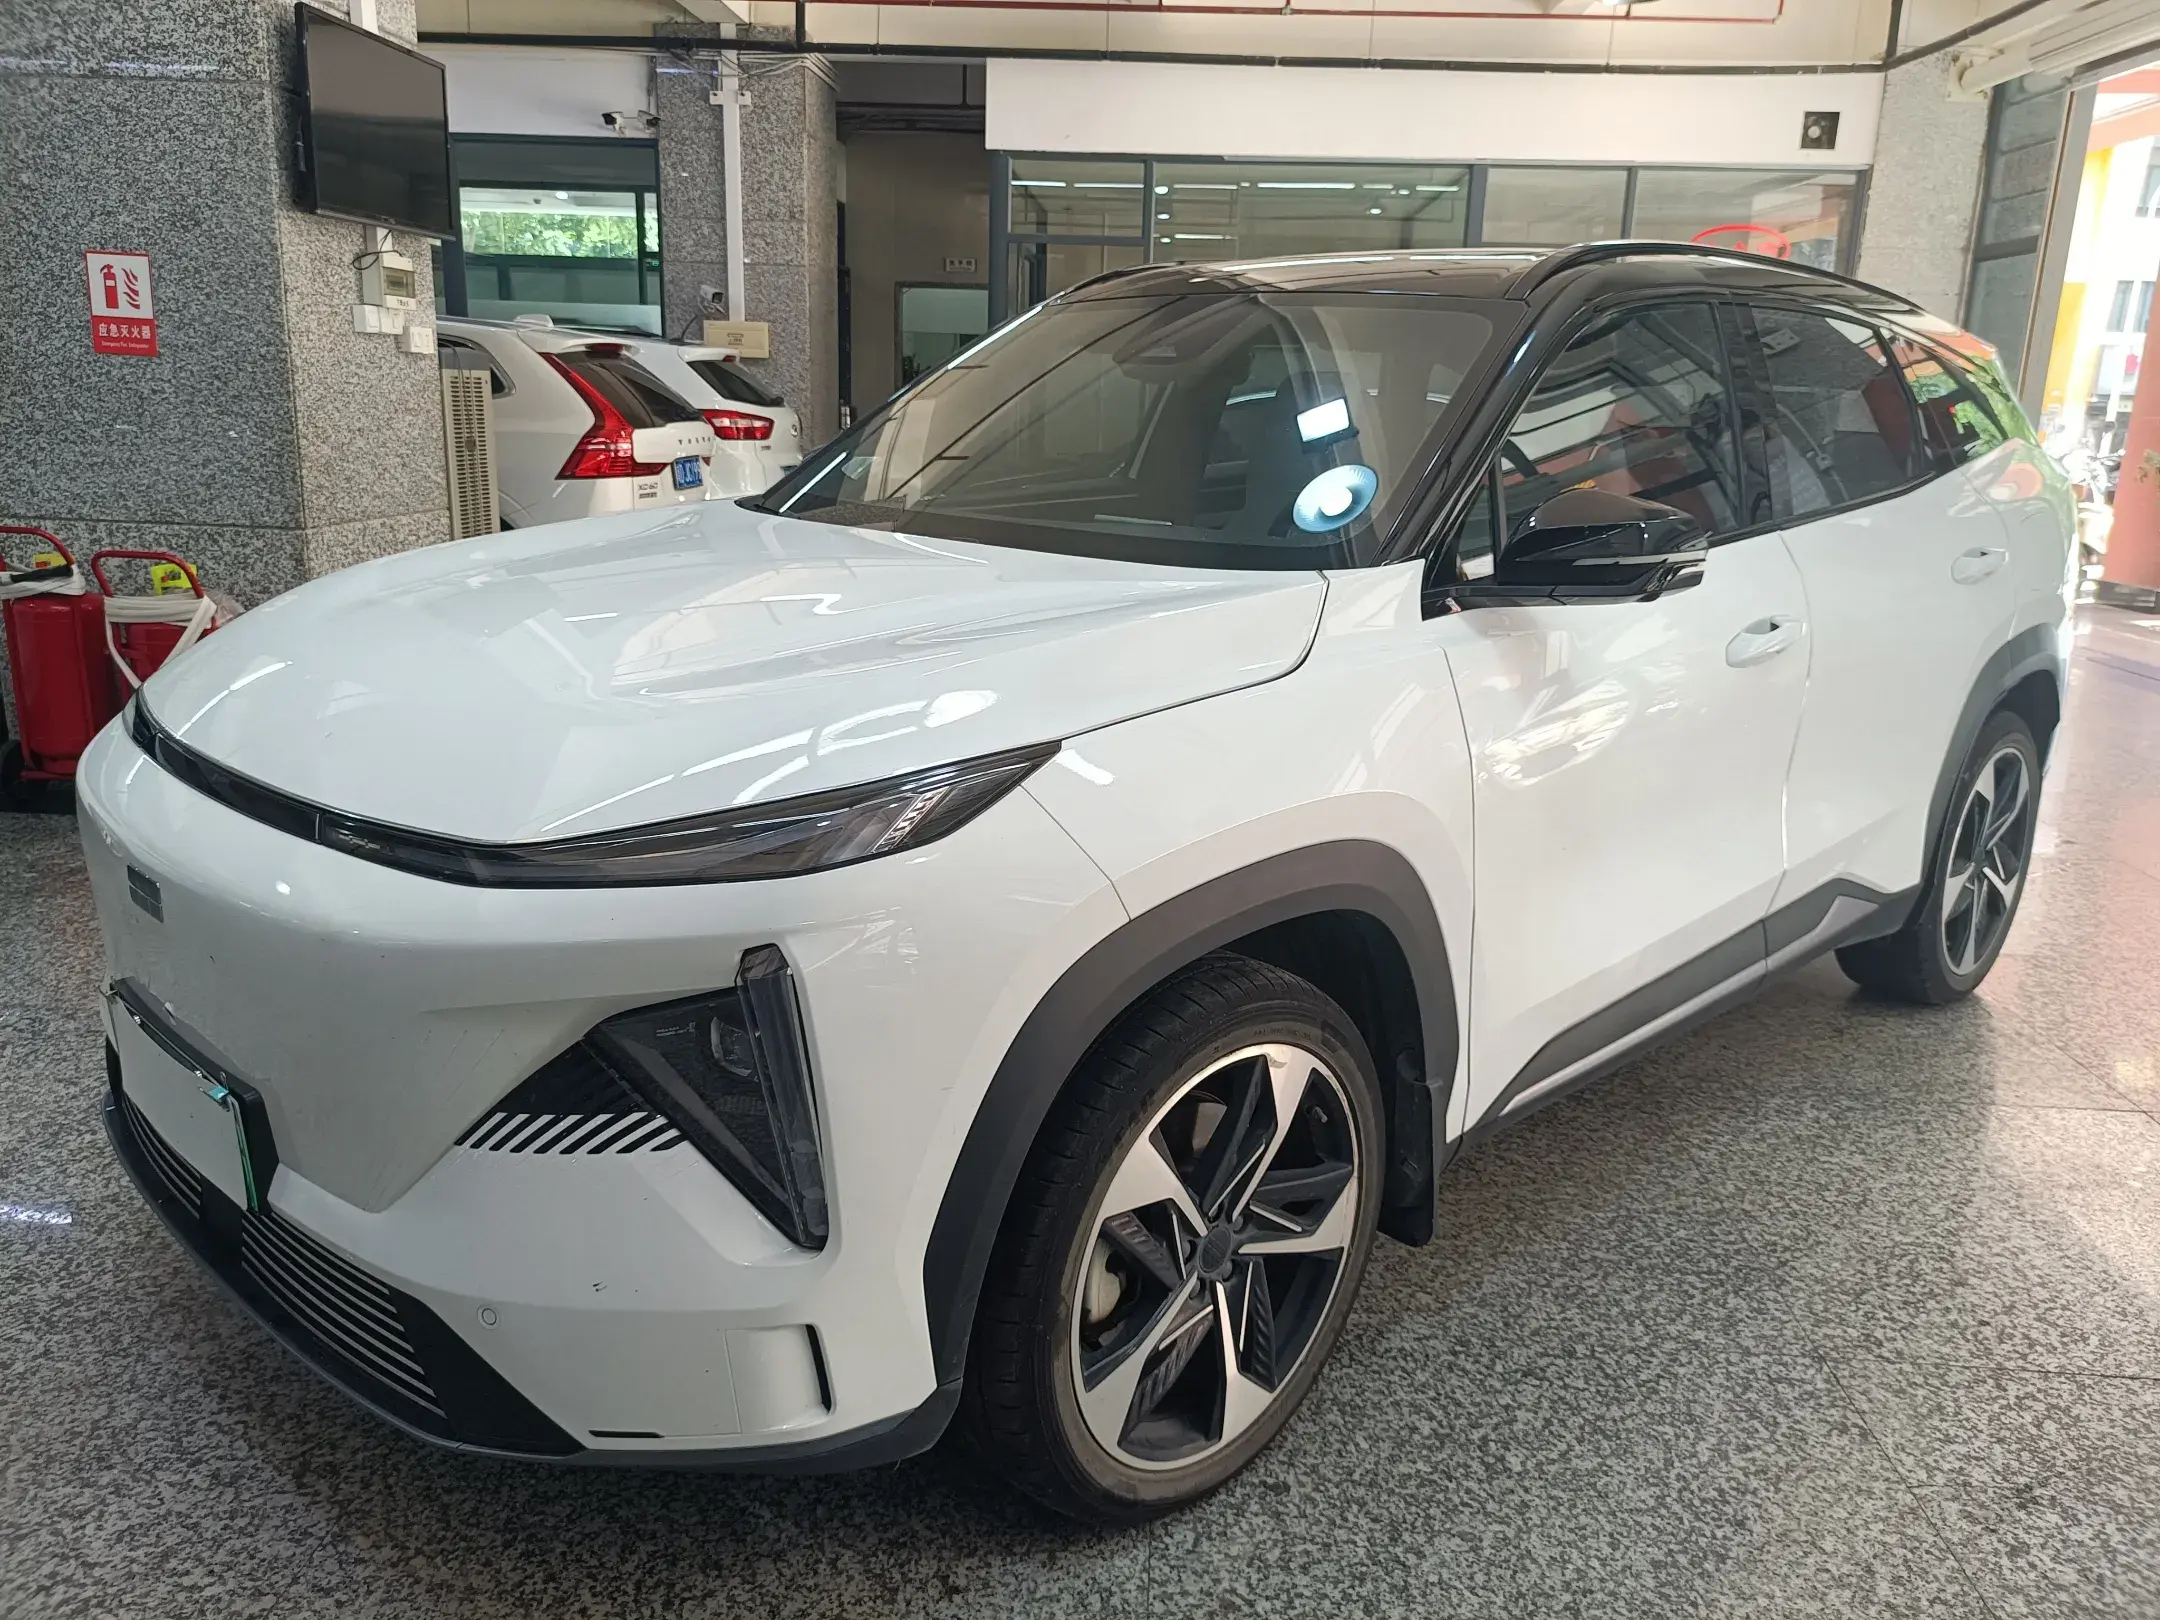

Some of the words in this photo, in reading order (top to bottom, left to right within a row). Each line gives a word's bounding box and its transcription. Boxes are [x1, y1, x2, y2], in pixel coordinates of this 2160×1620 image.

[99, 322, 151, 339] 应急灭火器
